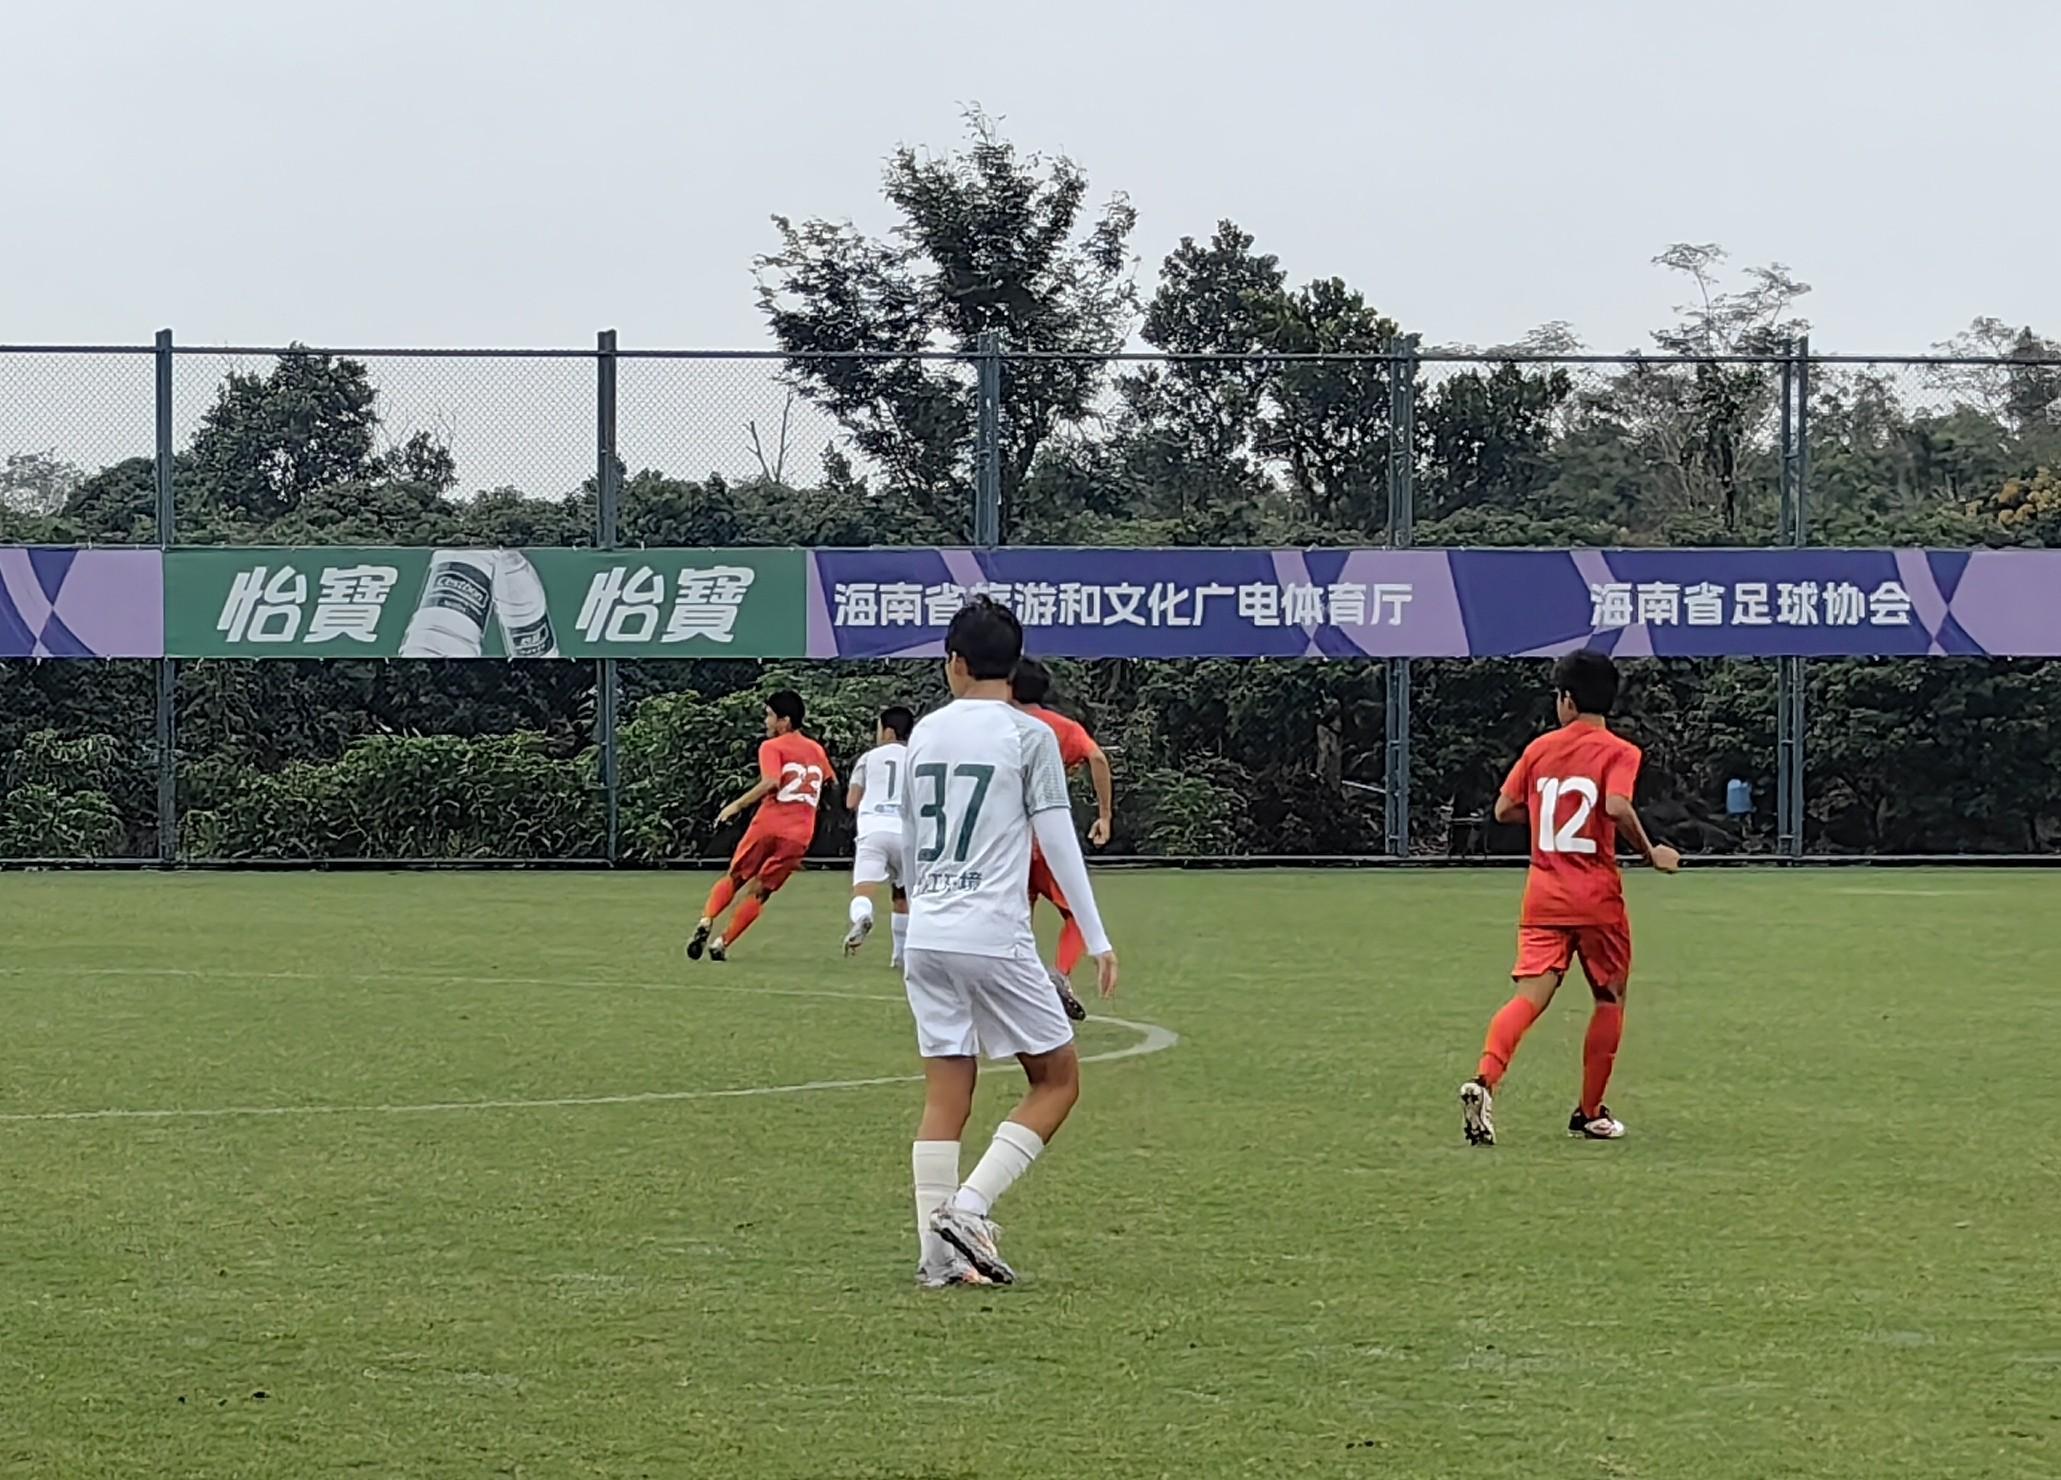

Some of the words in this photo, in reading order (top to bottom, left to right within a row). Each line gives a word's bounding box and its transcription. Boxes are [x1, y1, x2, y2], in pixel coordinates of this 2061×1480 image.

[217, 565, 398, 643] 怡寶
[576, 565, 756, 643] 怡寶
[1590, 582, 1911, 626] 海南省足球协会
[777, 762, 823, 807] 23
[915, 763, 995, 862] 37
[1537, 776, 1598, 853] 12
